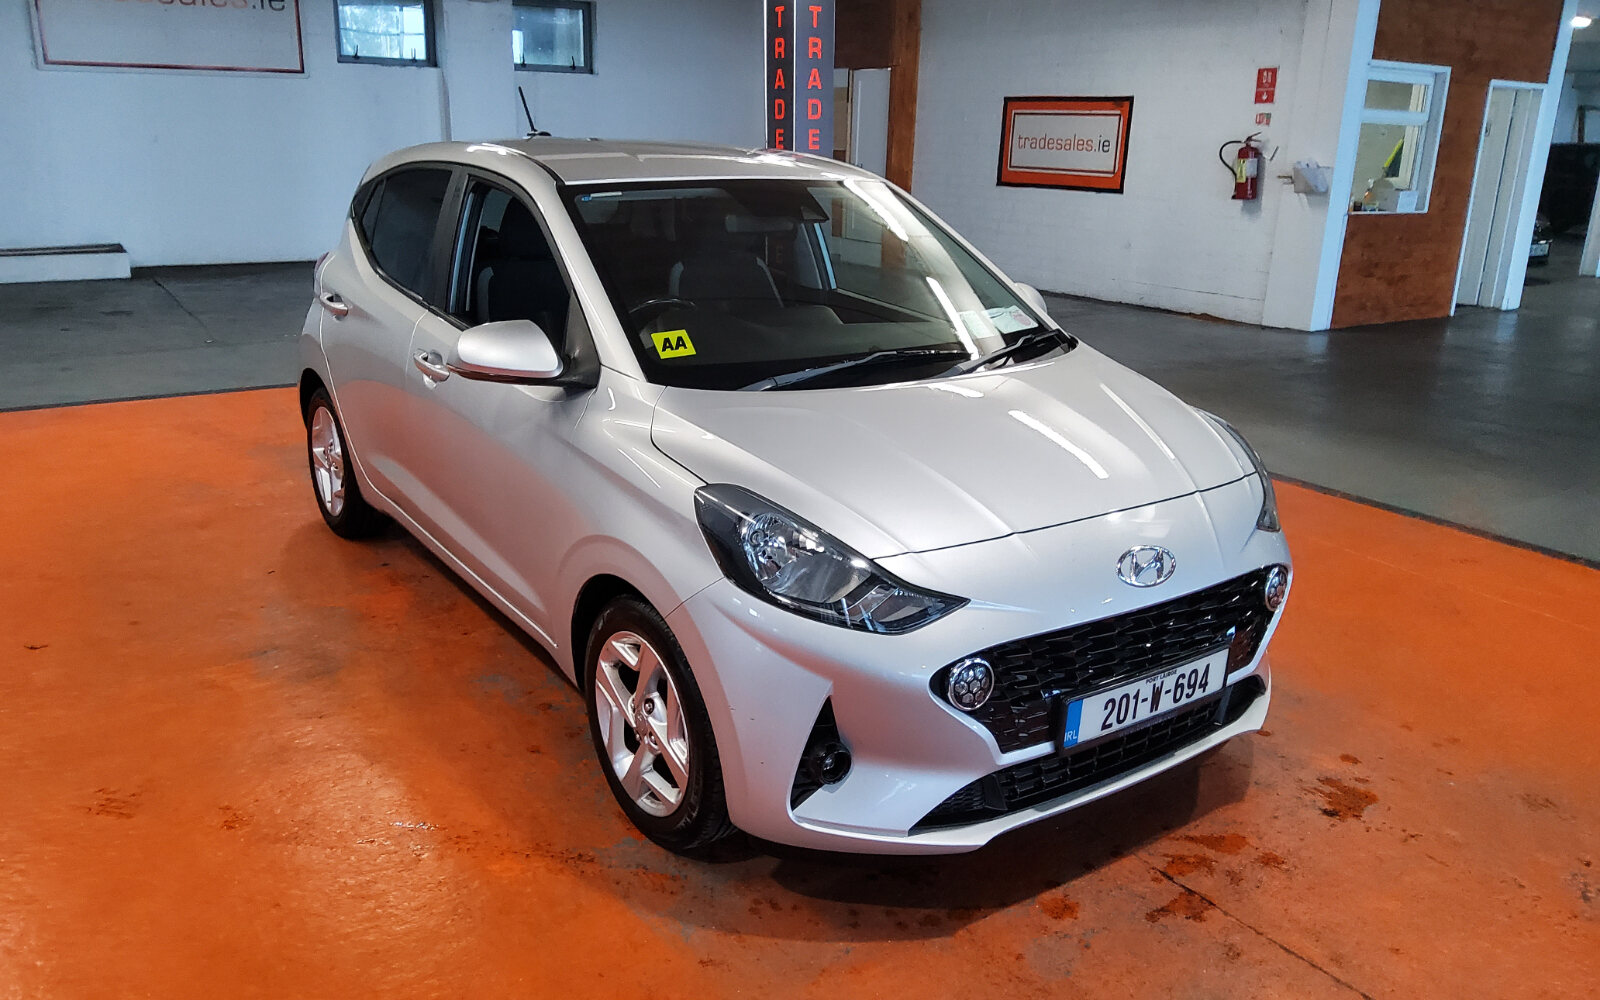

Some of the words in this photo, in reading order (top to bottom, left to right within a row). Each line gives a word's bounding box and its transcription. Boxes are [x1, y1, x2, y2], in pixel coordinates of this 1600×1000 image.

[774, 5, 785, 150] TRADE
[807, 5, 822, 150] TRADE
[1017, 133, 1111, 154] tradesales.ie
[661, 335, 688, 353] AA
[1100, 663, 1211, 732] 201-W-694
[1063, 729, 1078, 743] IRL
